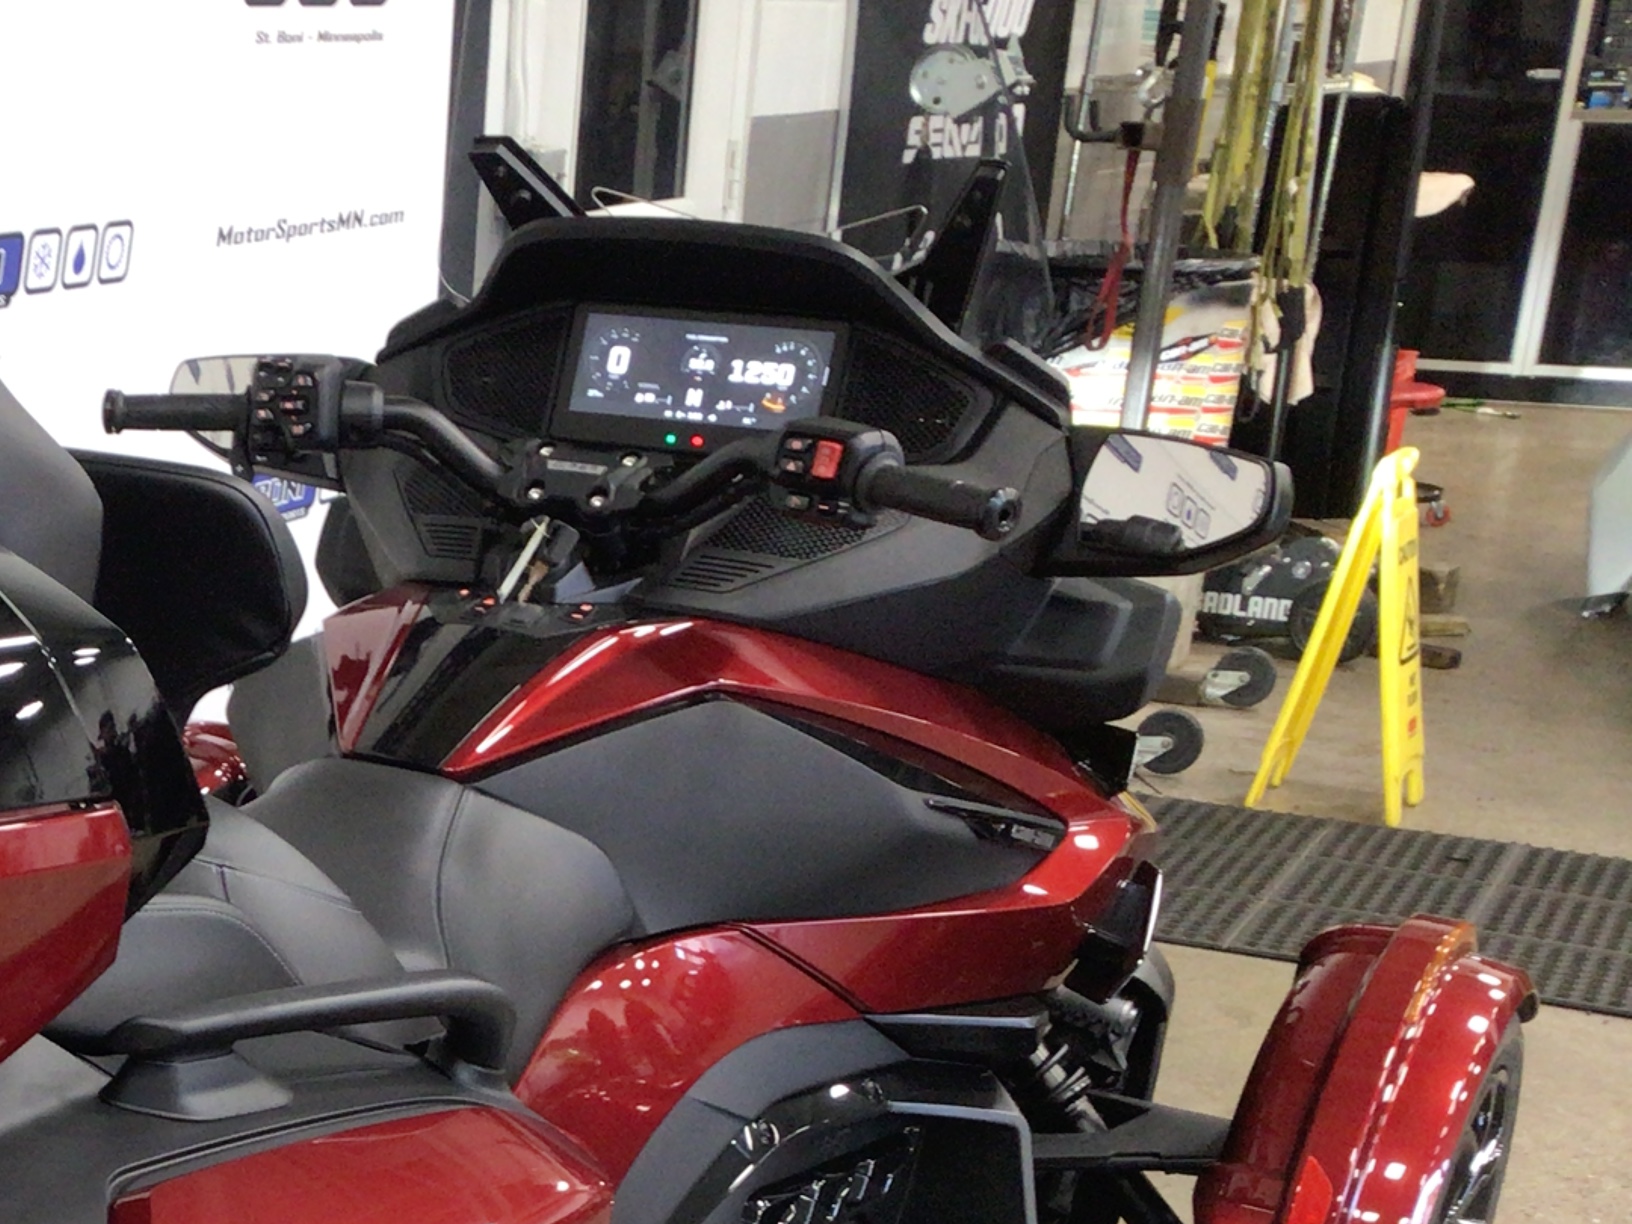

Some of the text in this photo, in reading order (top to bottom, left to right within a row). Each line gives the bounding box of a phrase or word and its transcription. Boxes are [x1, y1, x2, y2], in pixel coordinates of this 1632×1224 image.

[277, 30, 304, 43] Boni
[216, 208, 405, 247] MotorSportsMN.com
[607, 346, 631, 375] 0
[728, 359, 796, 387] 1250
